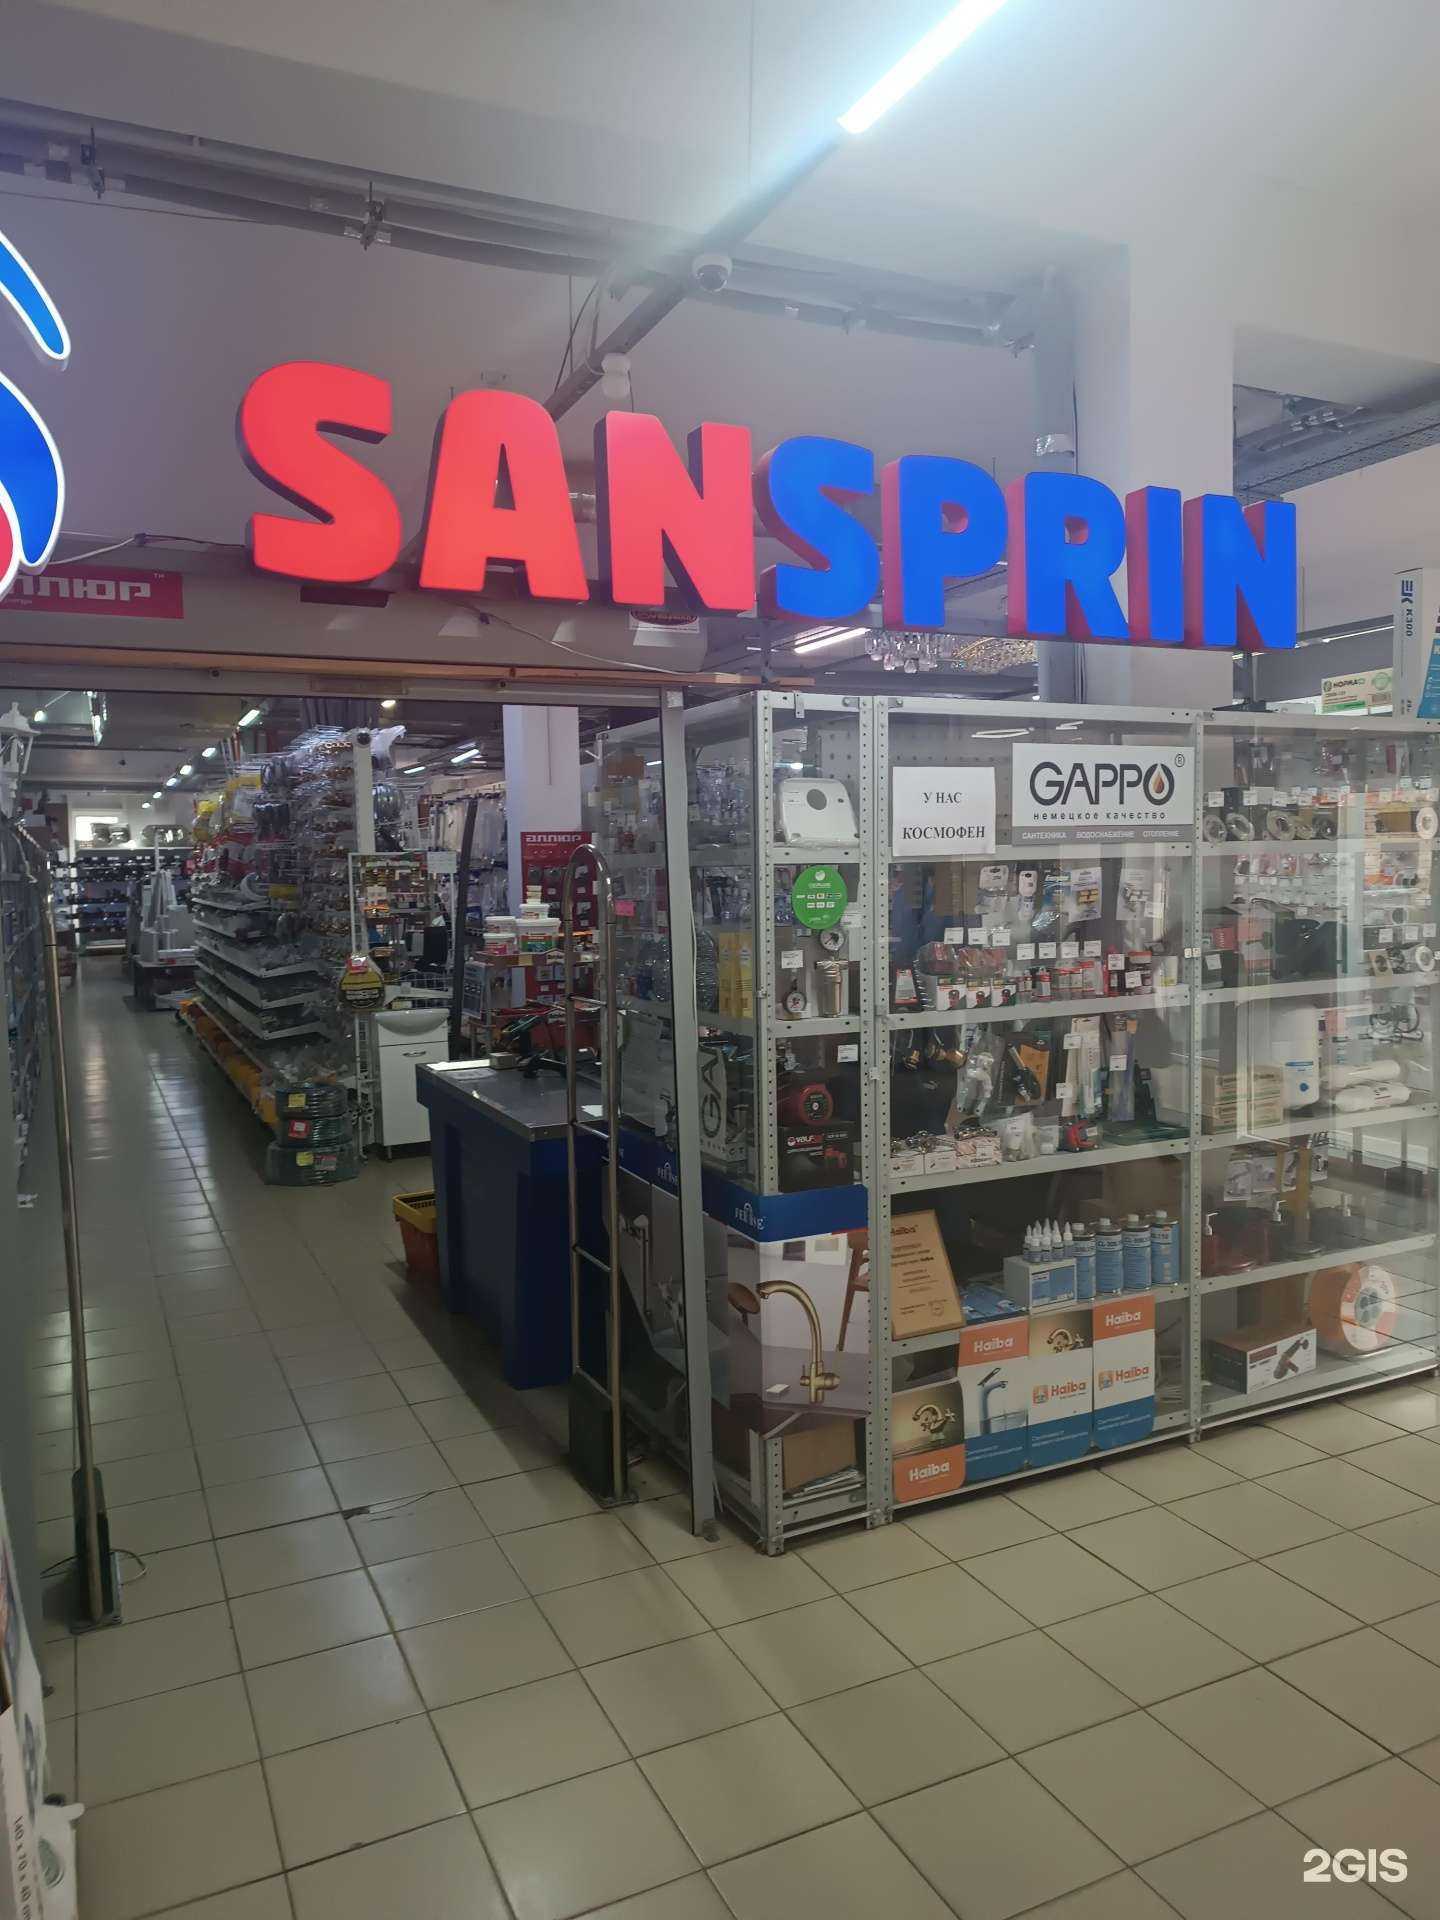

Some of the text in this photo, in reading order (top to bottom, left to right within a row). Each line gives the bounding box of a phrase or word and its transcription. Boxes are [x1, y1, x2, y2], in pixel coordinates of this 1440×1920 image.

[1029, 761, 1175, 806] GAPPO
[923, 791, 962, 804] У НАС
[1033, 811, 1166, 821] немецкое качество
[903, 825, 985, 840] КОСМОФЕН
[1105, 1311, 1141, 1327] Haiba
[973, 1337, 1015, 1353] Haiba
[1116, 1365, 1150, 1382] Haiba
[1051, 1381, 1087, 1397] Haiba
[908, 1462, 950, 1482] Haiba
